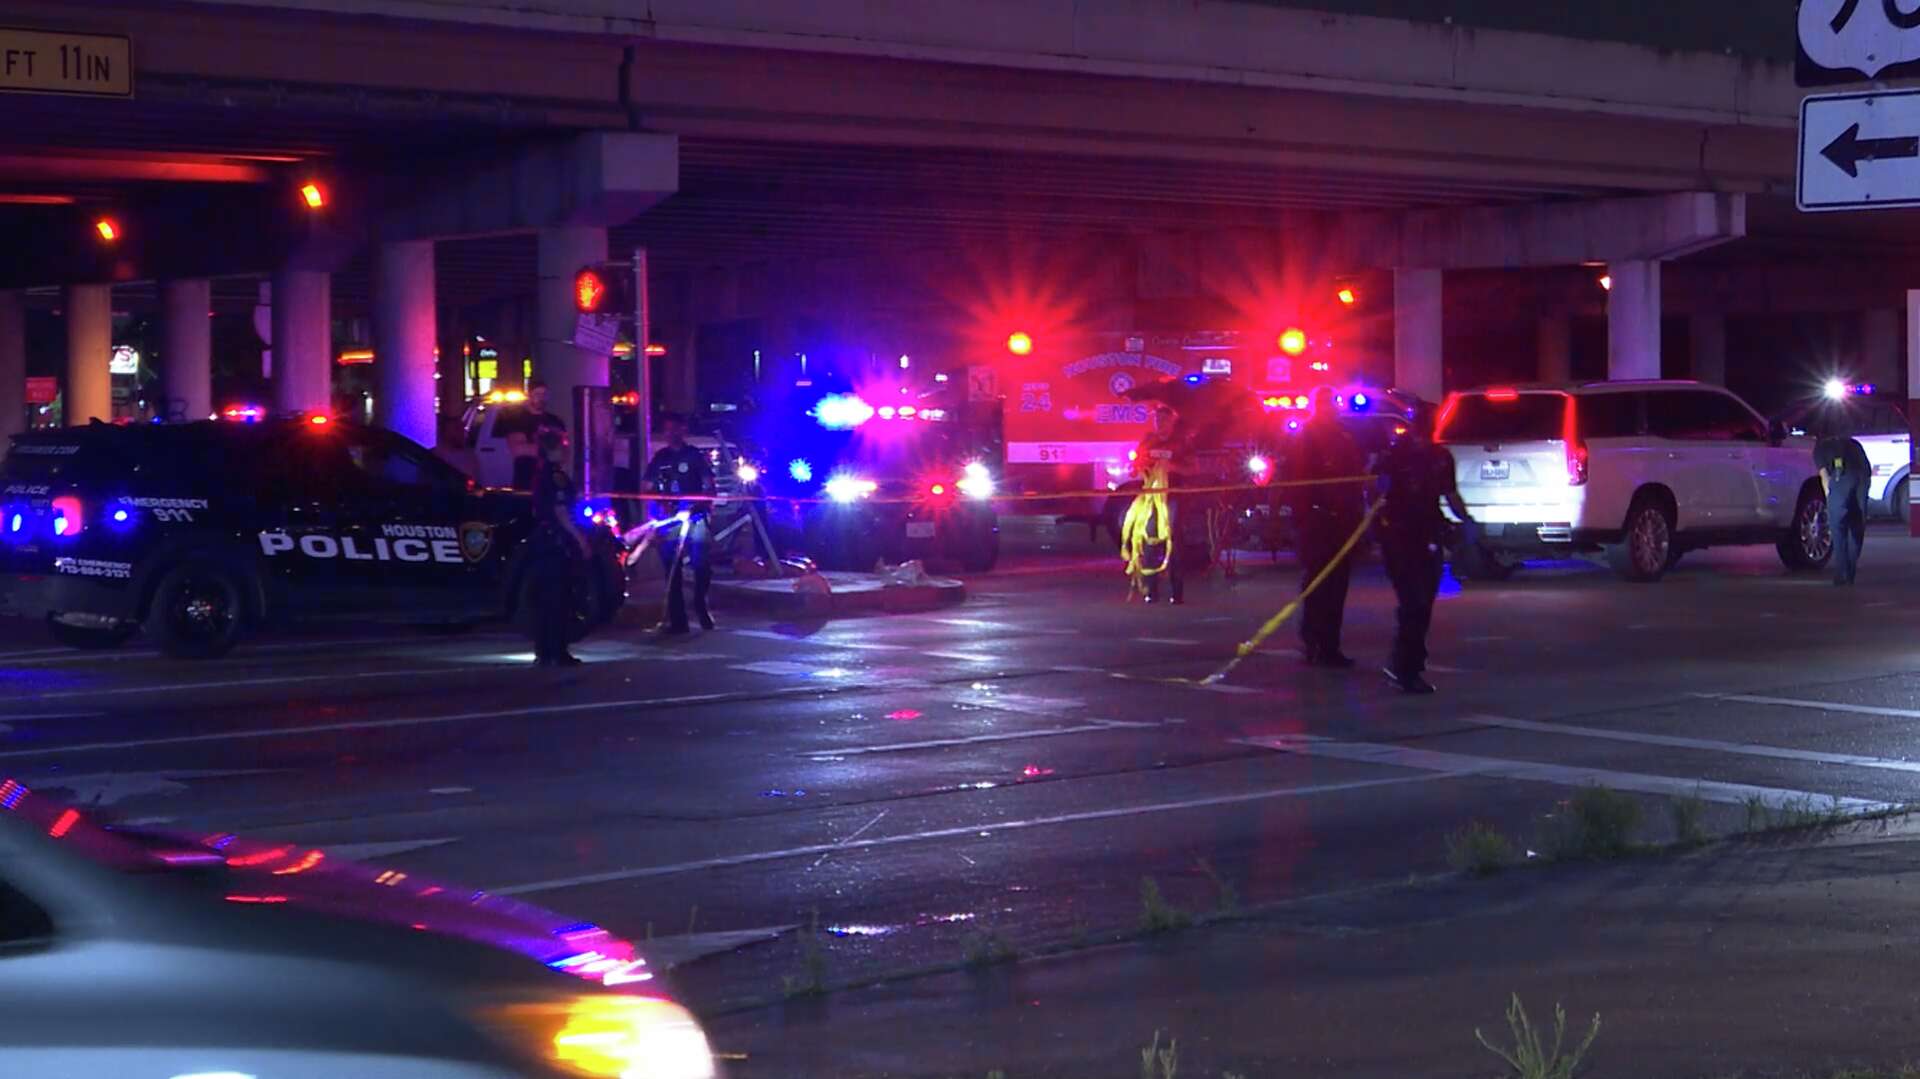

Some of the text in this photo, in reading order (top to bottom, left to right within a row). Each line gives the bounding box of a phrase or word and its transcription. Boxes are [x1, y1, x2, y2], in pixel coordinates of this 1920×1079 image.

[6, 49, 36, 77] FT
[1020, 392, 1051, 412] 24
[1096, 403, 1148, 423] EMS
[5, 485, 50, 496] POLICE
[153, 508, 193, 522] 911
[381, 524, 457, 539] HOUSTON
[258, 531, 464, 563] POLICE
